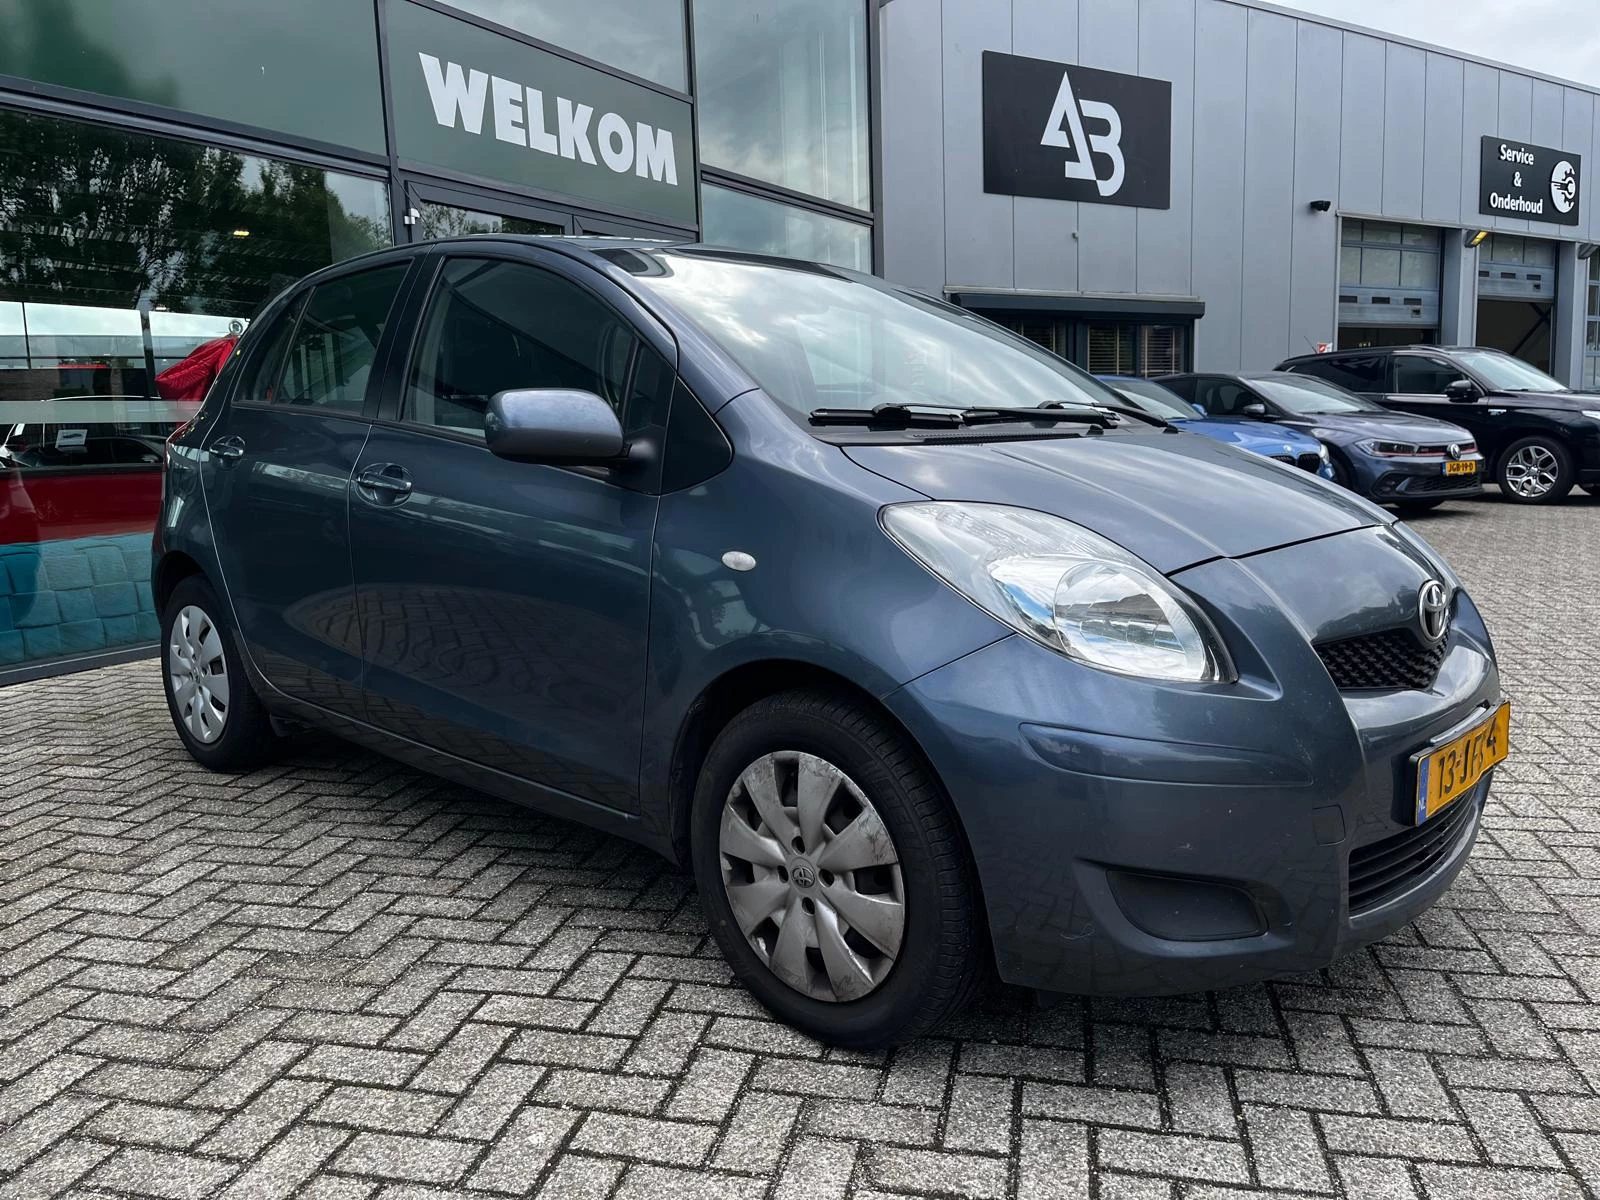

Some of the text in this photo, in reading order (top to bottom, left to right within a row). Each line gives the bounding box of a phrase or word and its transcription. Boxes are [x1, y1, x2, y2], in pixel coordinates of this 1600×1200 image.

[418, 52, 678, 185] WELKOM
[1500, 144, 1534, 165] Service
[1513, 171, 1522, 187] &
[1489, 192, 1543, 214] Onderhoud
